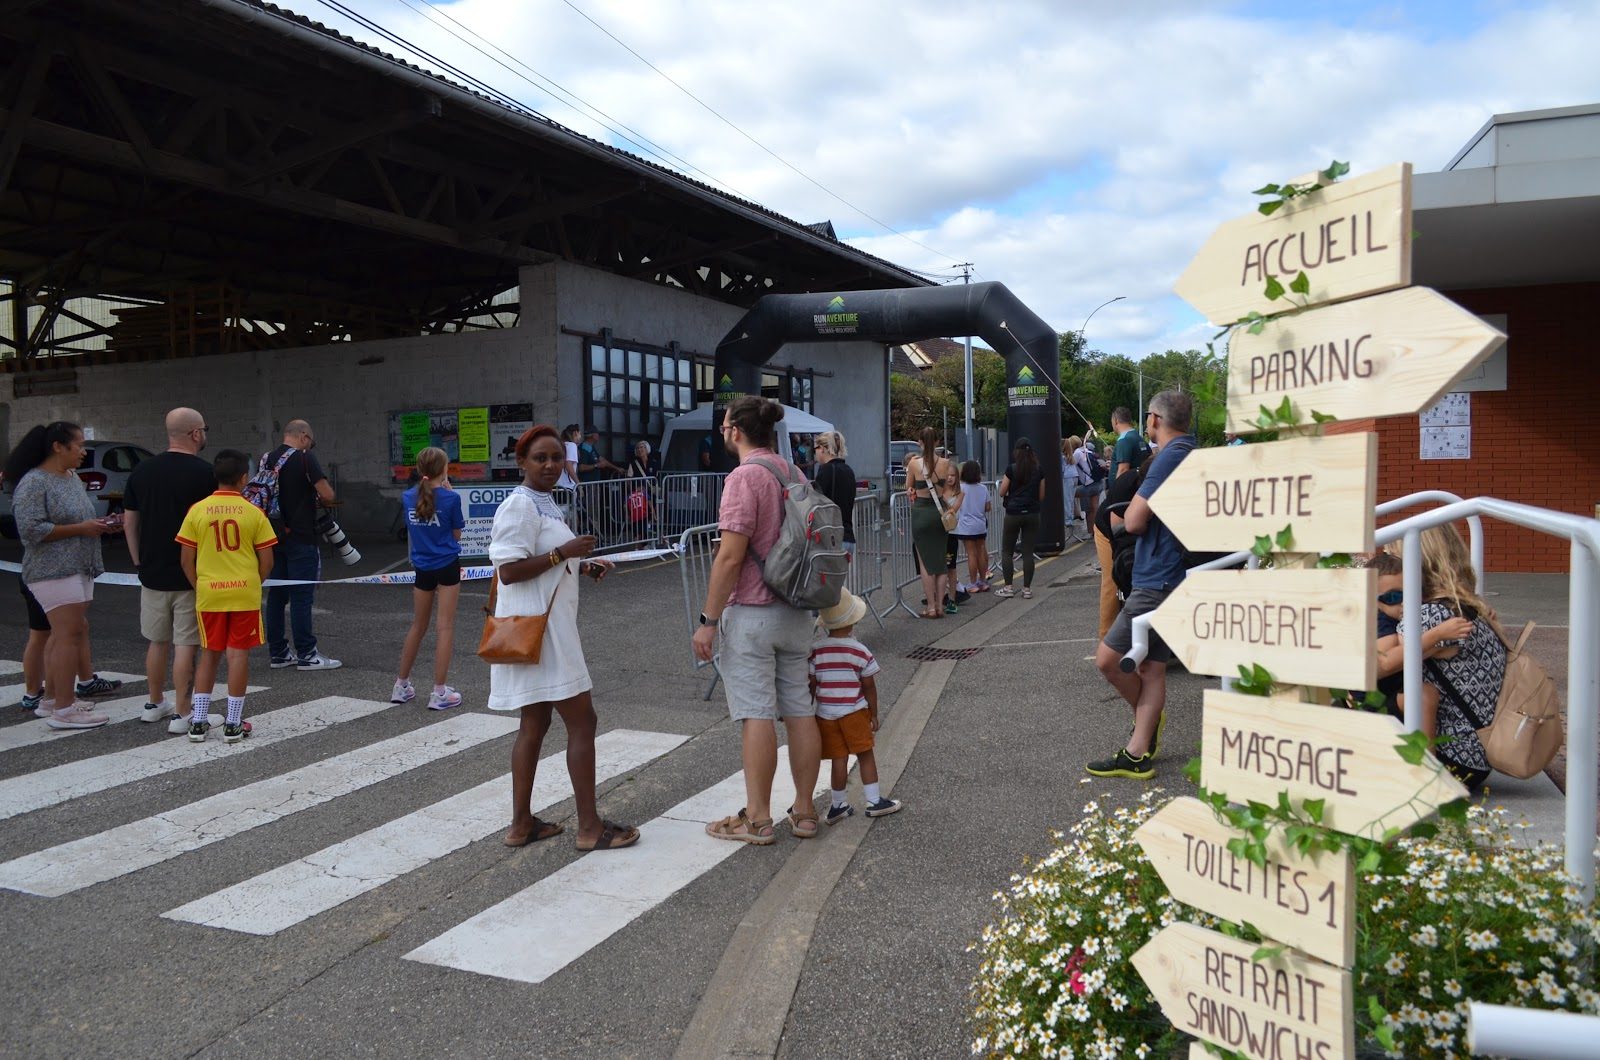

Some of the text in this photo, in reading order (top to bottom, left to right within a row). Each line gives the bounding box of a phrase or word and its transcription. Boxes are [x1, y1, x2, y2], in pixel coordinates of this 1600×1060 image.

[1241, 211, 1388, 286] ACCUEIL
[1250, 334, 1373, 394] PARKING
[206, 505, 243, 515] MATHYS
[1205, 475, 1313, 518] BUVETTE
[209, 518, 241, 552] 10
[210, 580, 248, 590] WINAMAX
[1193, 602, 1323, 650] GARDERIE
[1221, 727, 1357, 797] MASSAGE
[1183, 833, 1338, 929] TOILETTES 1
[1205, 946, 1326, 1026] RETRAIT
